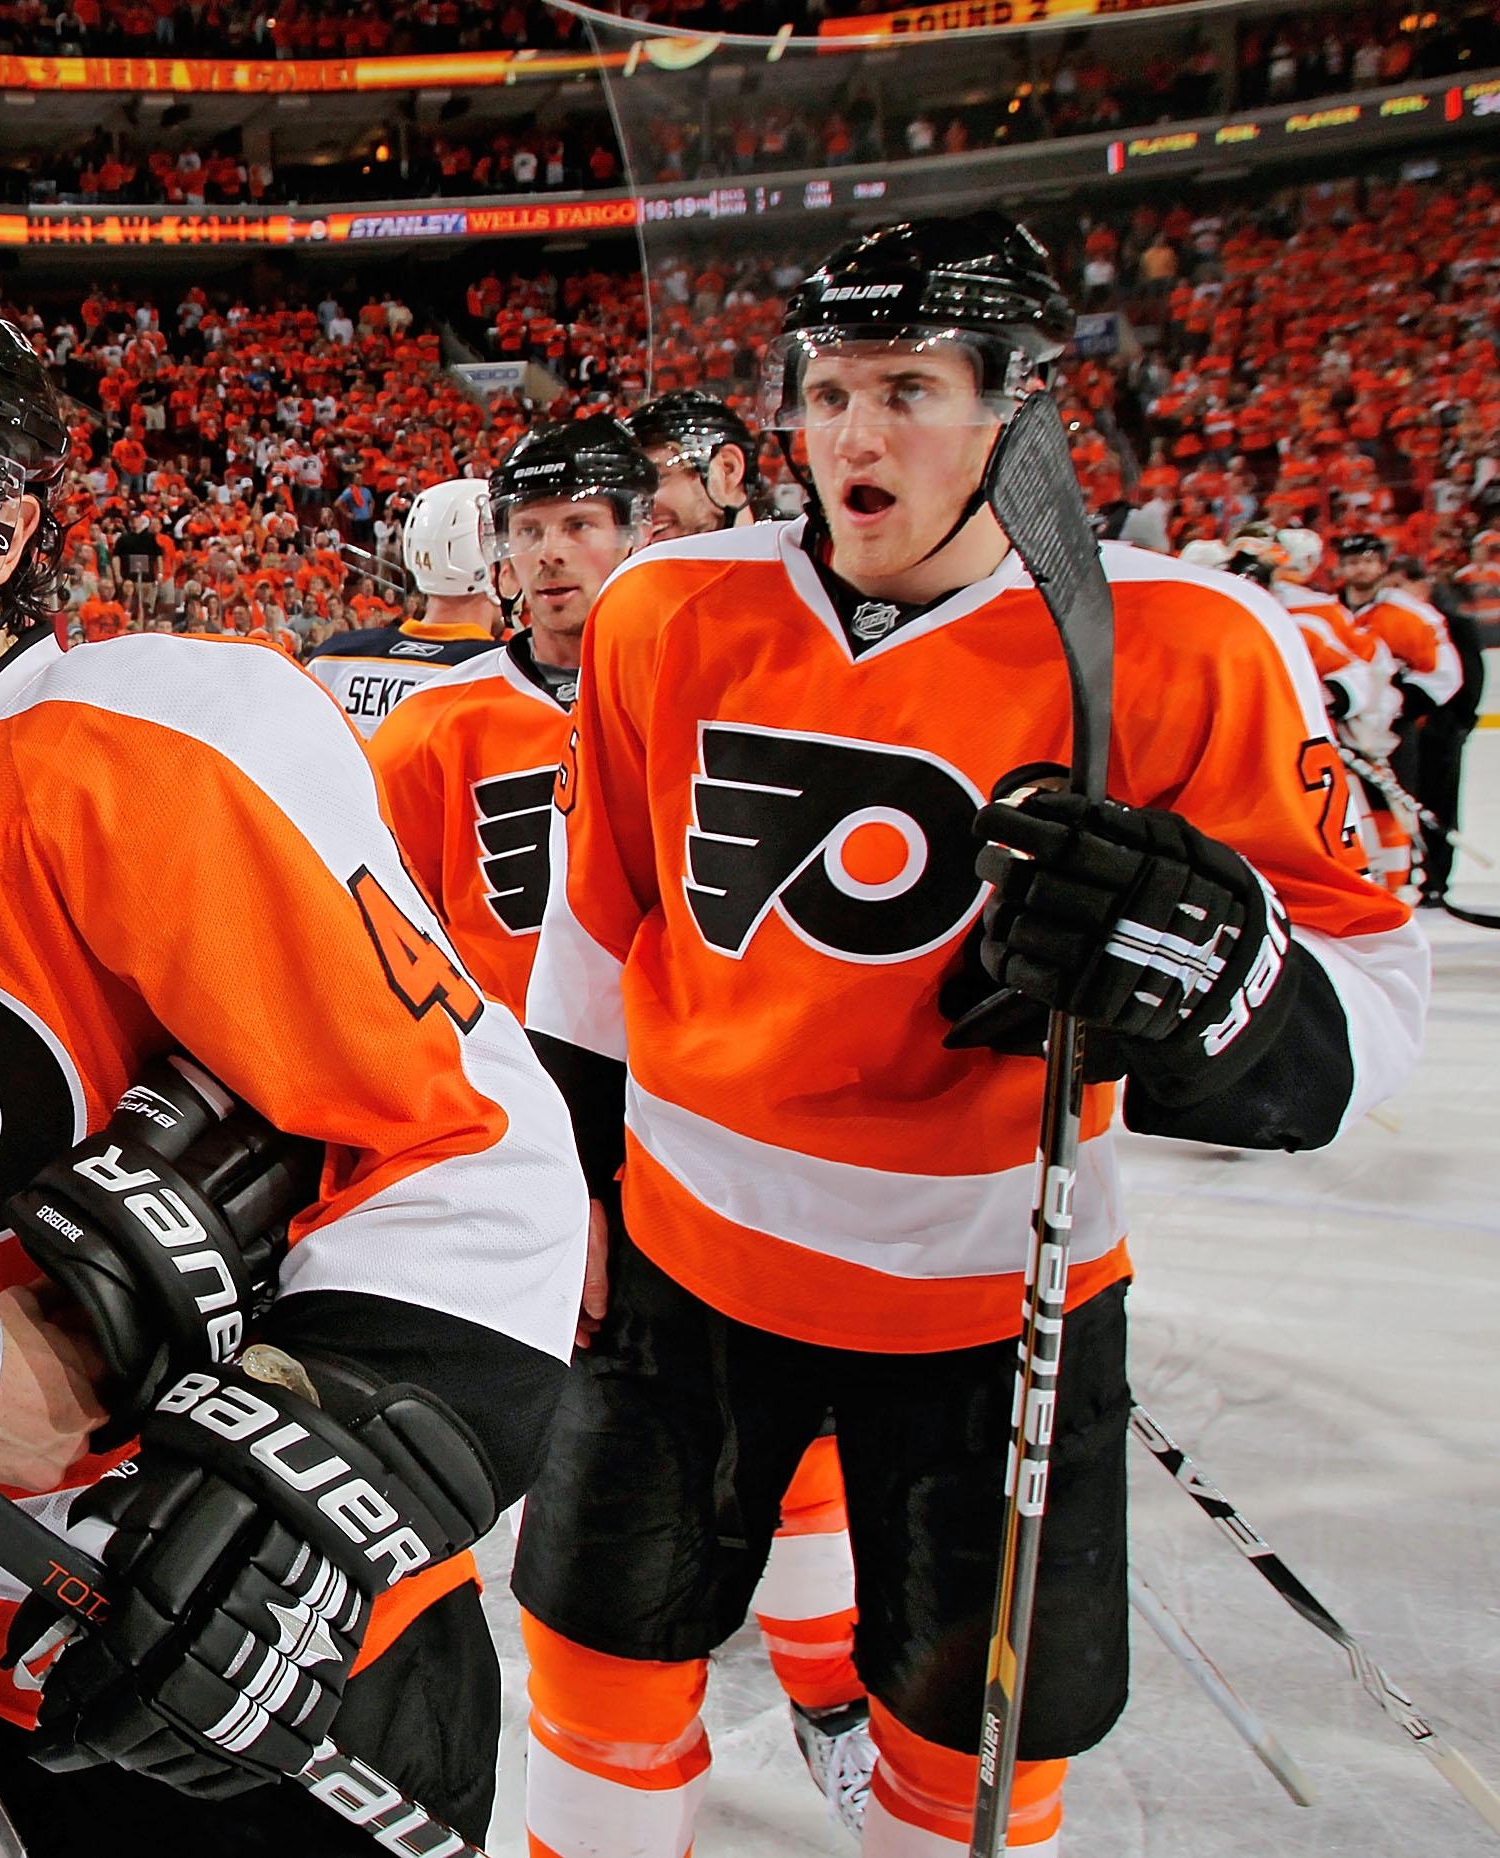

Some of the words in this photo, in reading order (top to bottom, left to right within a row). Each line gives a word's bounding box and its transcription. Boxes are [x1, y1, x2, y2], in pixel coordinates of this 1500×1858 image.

[350, 213, 462, 239] STANLEY
[467, 207, 551, 231] WELLS
[555, 202, 637, 227] FARGO
[819, 284, 904, 302] BAUER
[513, 462, 567, 479] BAUER
[414, 551, 432, 571] 44
[345, 676, 424, 716] SEKE
[35, 1205, 85, 1243] BRIERE
[71, 1143, 243, 1365] AUER
[154, 1372, 432, 1588] BAUER
[979, 1711, 1001, 1787] BAUER
